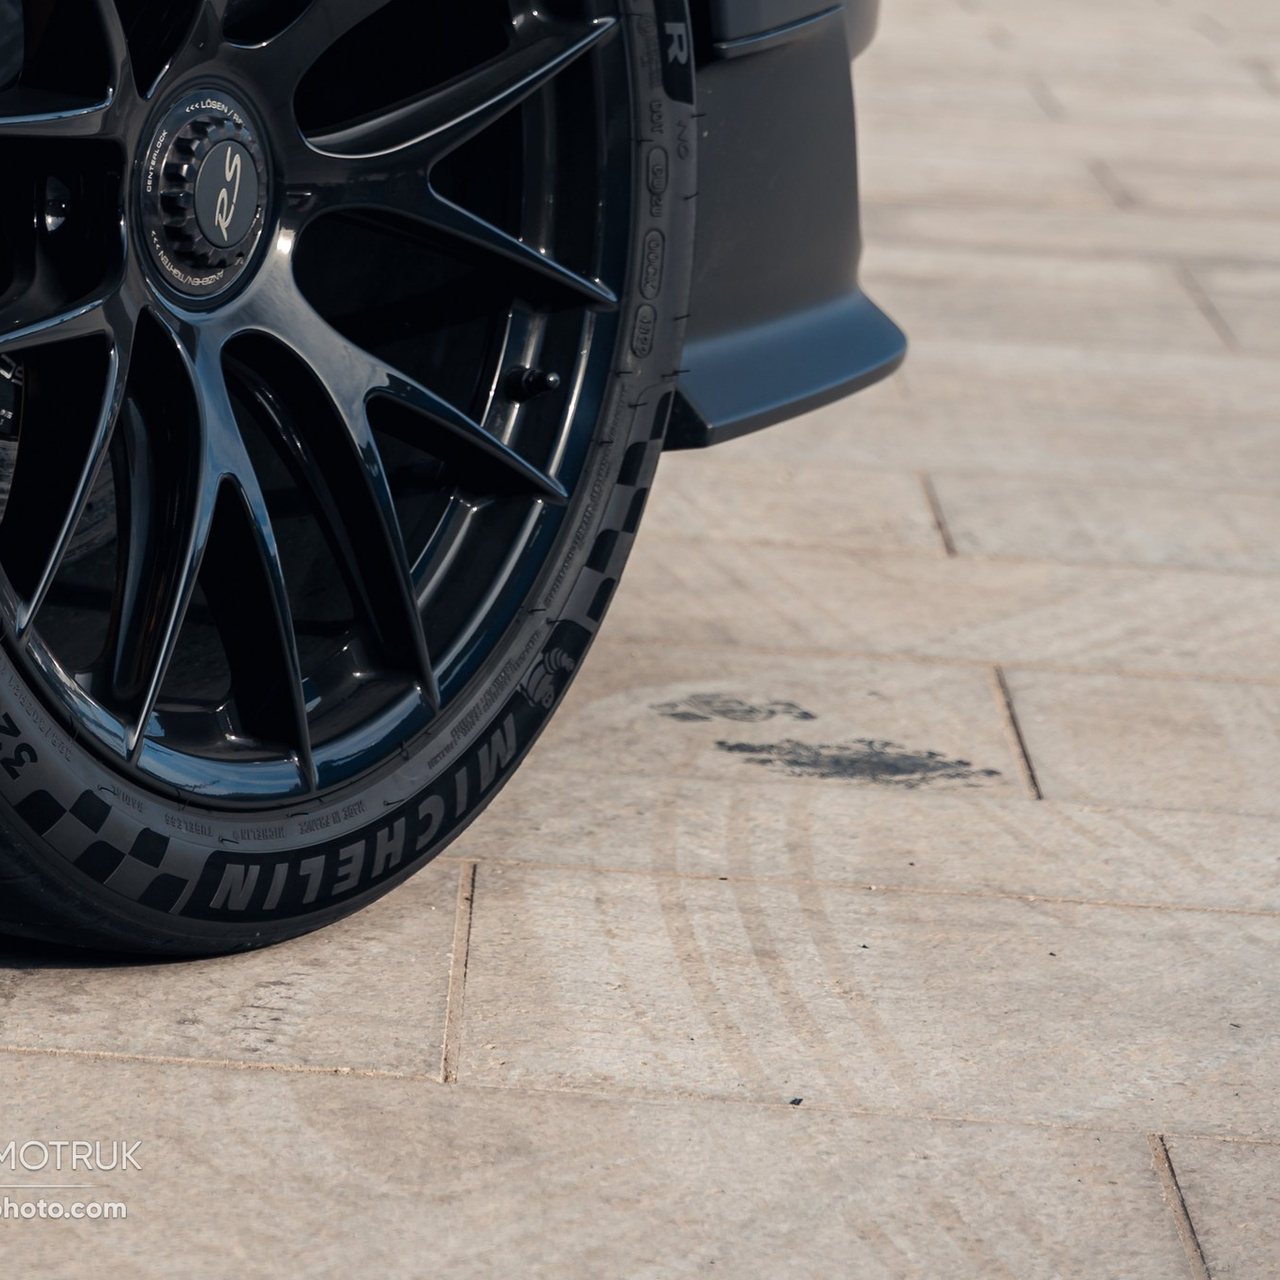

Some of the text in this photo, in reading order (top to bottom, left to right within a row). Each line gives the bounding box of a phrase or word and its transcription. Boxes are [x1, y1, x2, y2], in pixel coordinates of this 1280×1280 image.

[664, 20, 691, 67] R
[648, 99, 665, 134] DOT
[146, 129, 169, 193] CENTERLOCK
[161, 812, 215, 838] TUBELESS
[212, 718, 518, 912] MICHELIN
[297, 813, 332, 834] FRANCE
[341, 799, 366, 821] MADE
[238, 825, 286, 841] MICHELIN
